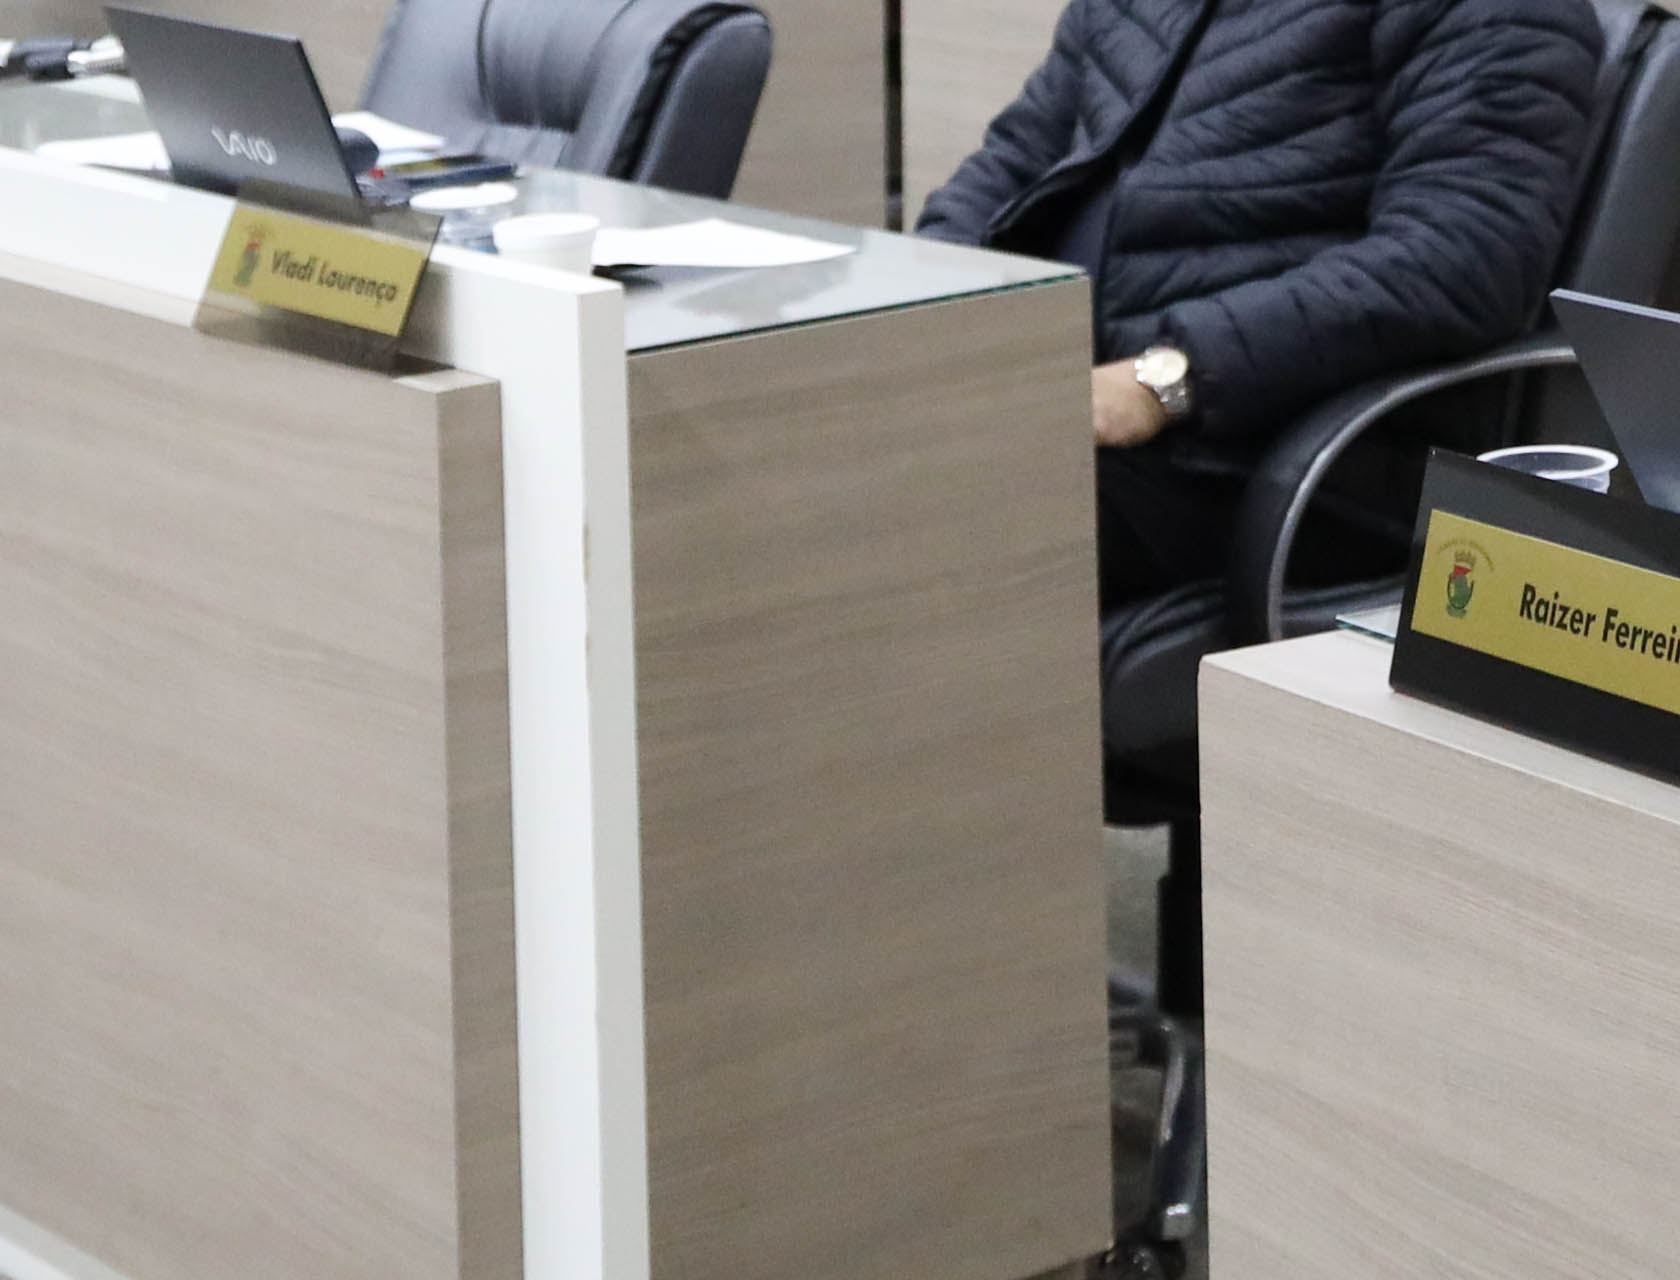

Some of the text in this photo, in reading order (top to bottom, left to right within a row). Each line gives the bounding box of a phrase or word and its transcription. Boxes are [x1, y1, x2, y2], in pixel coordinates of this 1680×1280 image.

[210, 126, 277, 166] VAIO
[271, 249, 398, 309] Vladi Lourenço
[1519, 583, 1596, 638] Raizer
